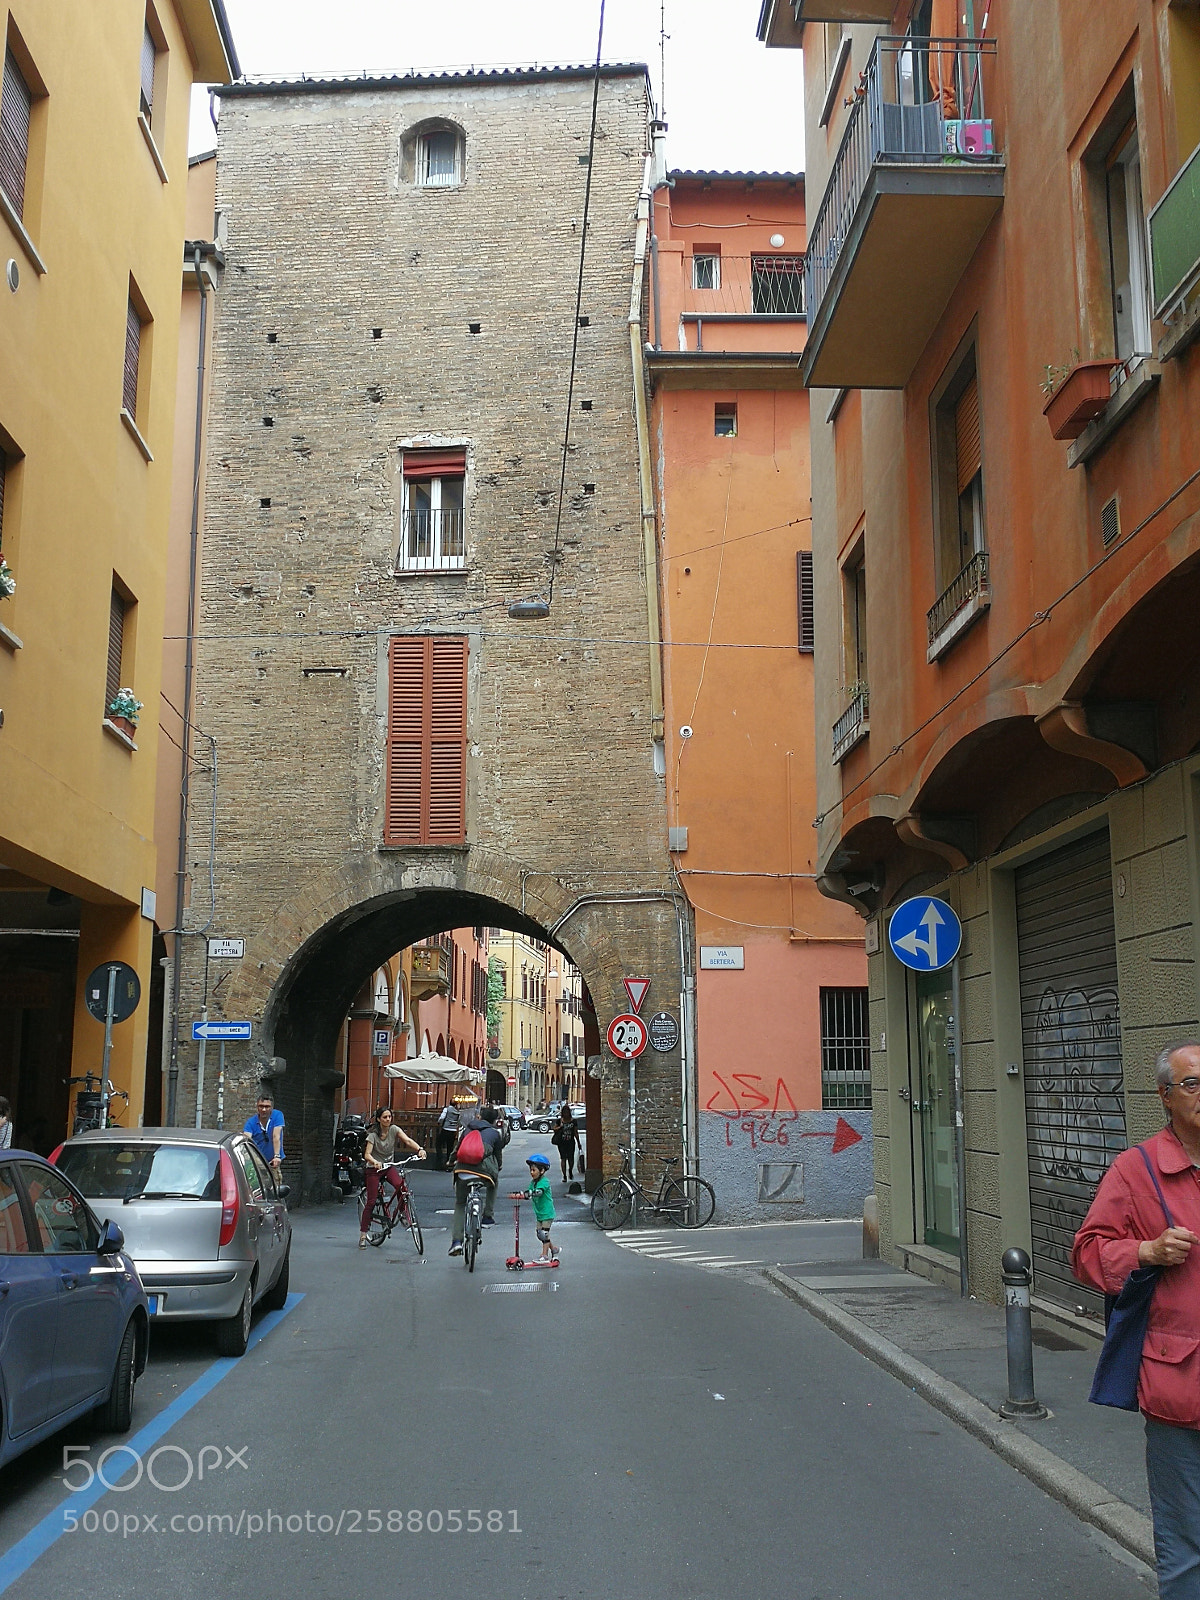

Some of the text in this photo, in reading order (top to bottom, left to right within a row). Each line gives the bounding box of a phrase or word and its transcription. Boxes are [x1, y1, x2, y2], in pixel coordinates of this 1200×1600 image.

[379, 1033, 386, 1042] P
[616, 1026, 625, 1045] 2
[725, 1120, 789, 1150] 1926
